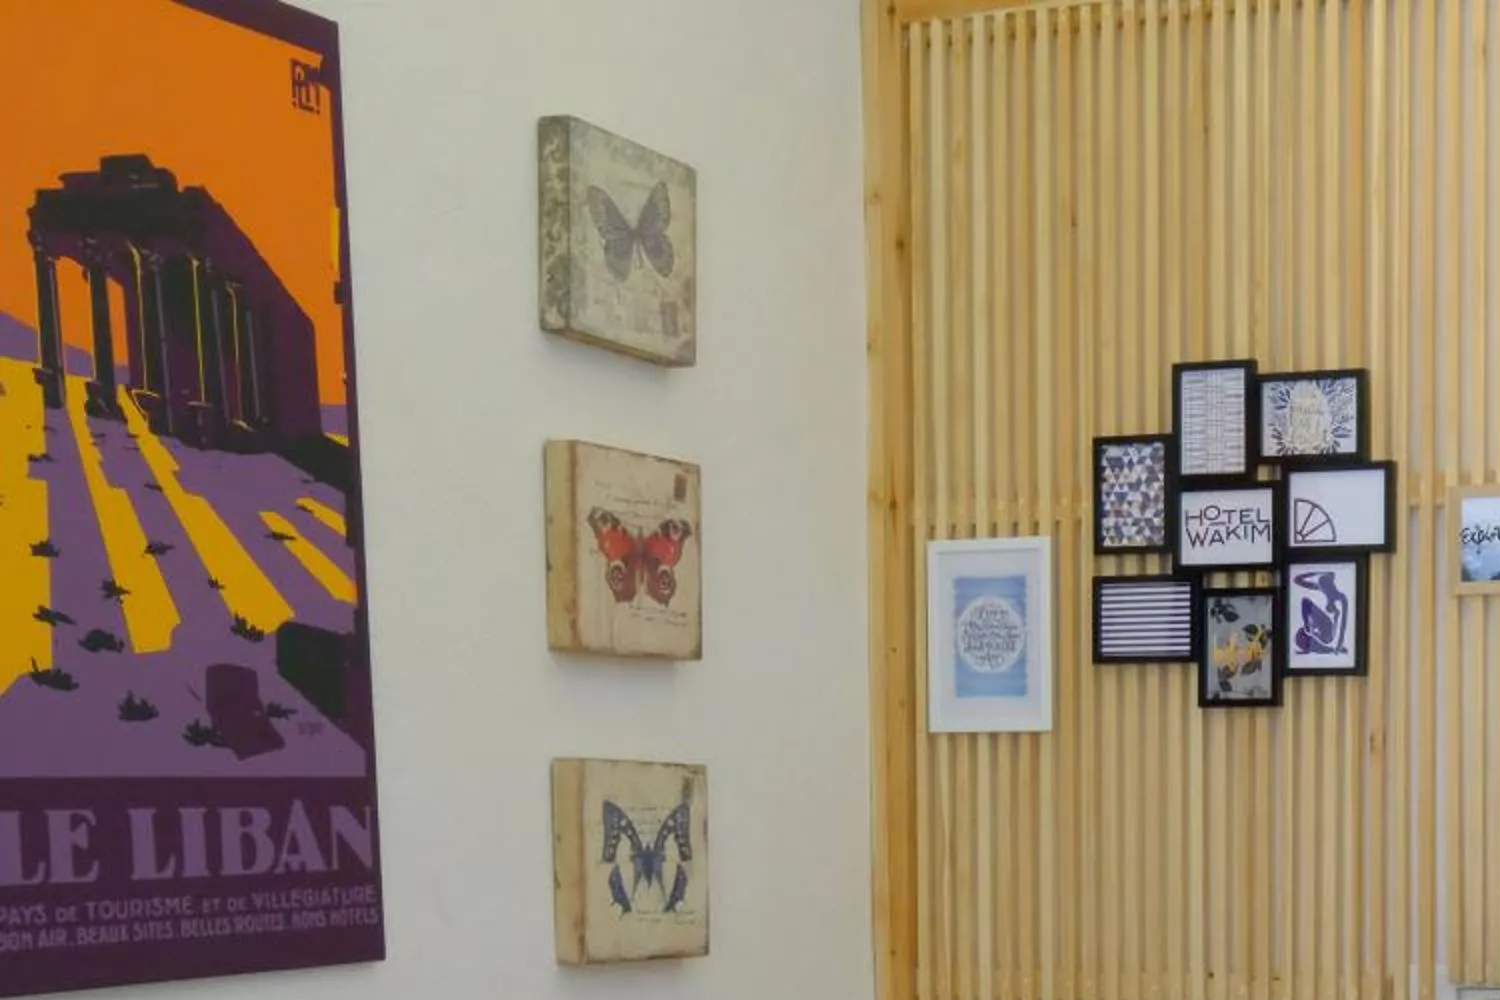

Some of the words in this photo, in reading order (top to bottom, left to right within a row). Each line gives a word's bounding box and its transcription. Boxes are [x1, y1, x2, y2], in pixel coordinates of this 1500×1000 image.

[1184, 504, 1270, 527] HOTEL
[1185, 523, 1271, 549] WAKIM
[0, 808, 99, 886] LE
[128, 799, 373, 880] LIBAN
[86, 897, 195, 921] TOURISME
